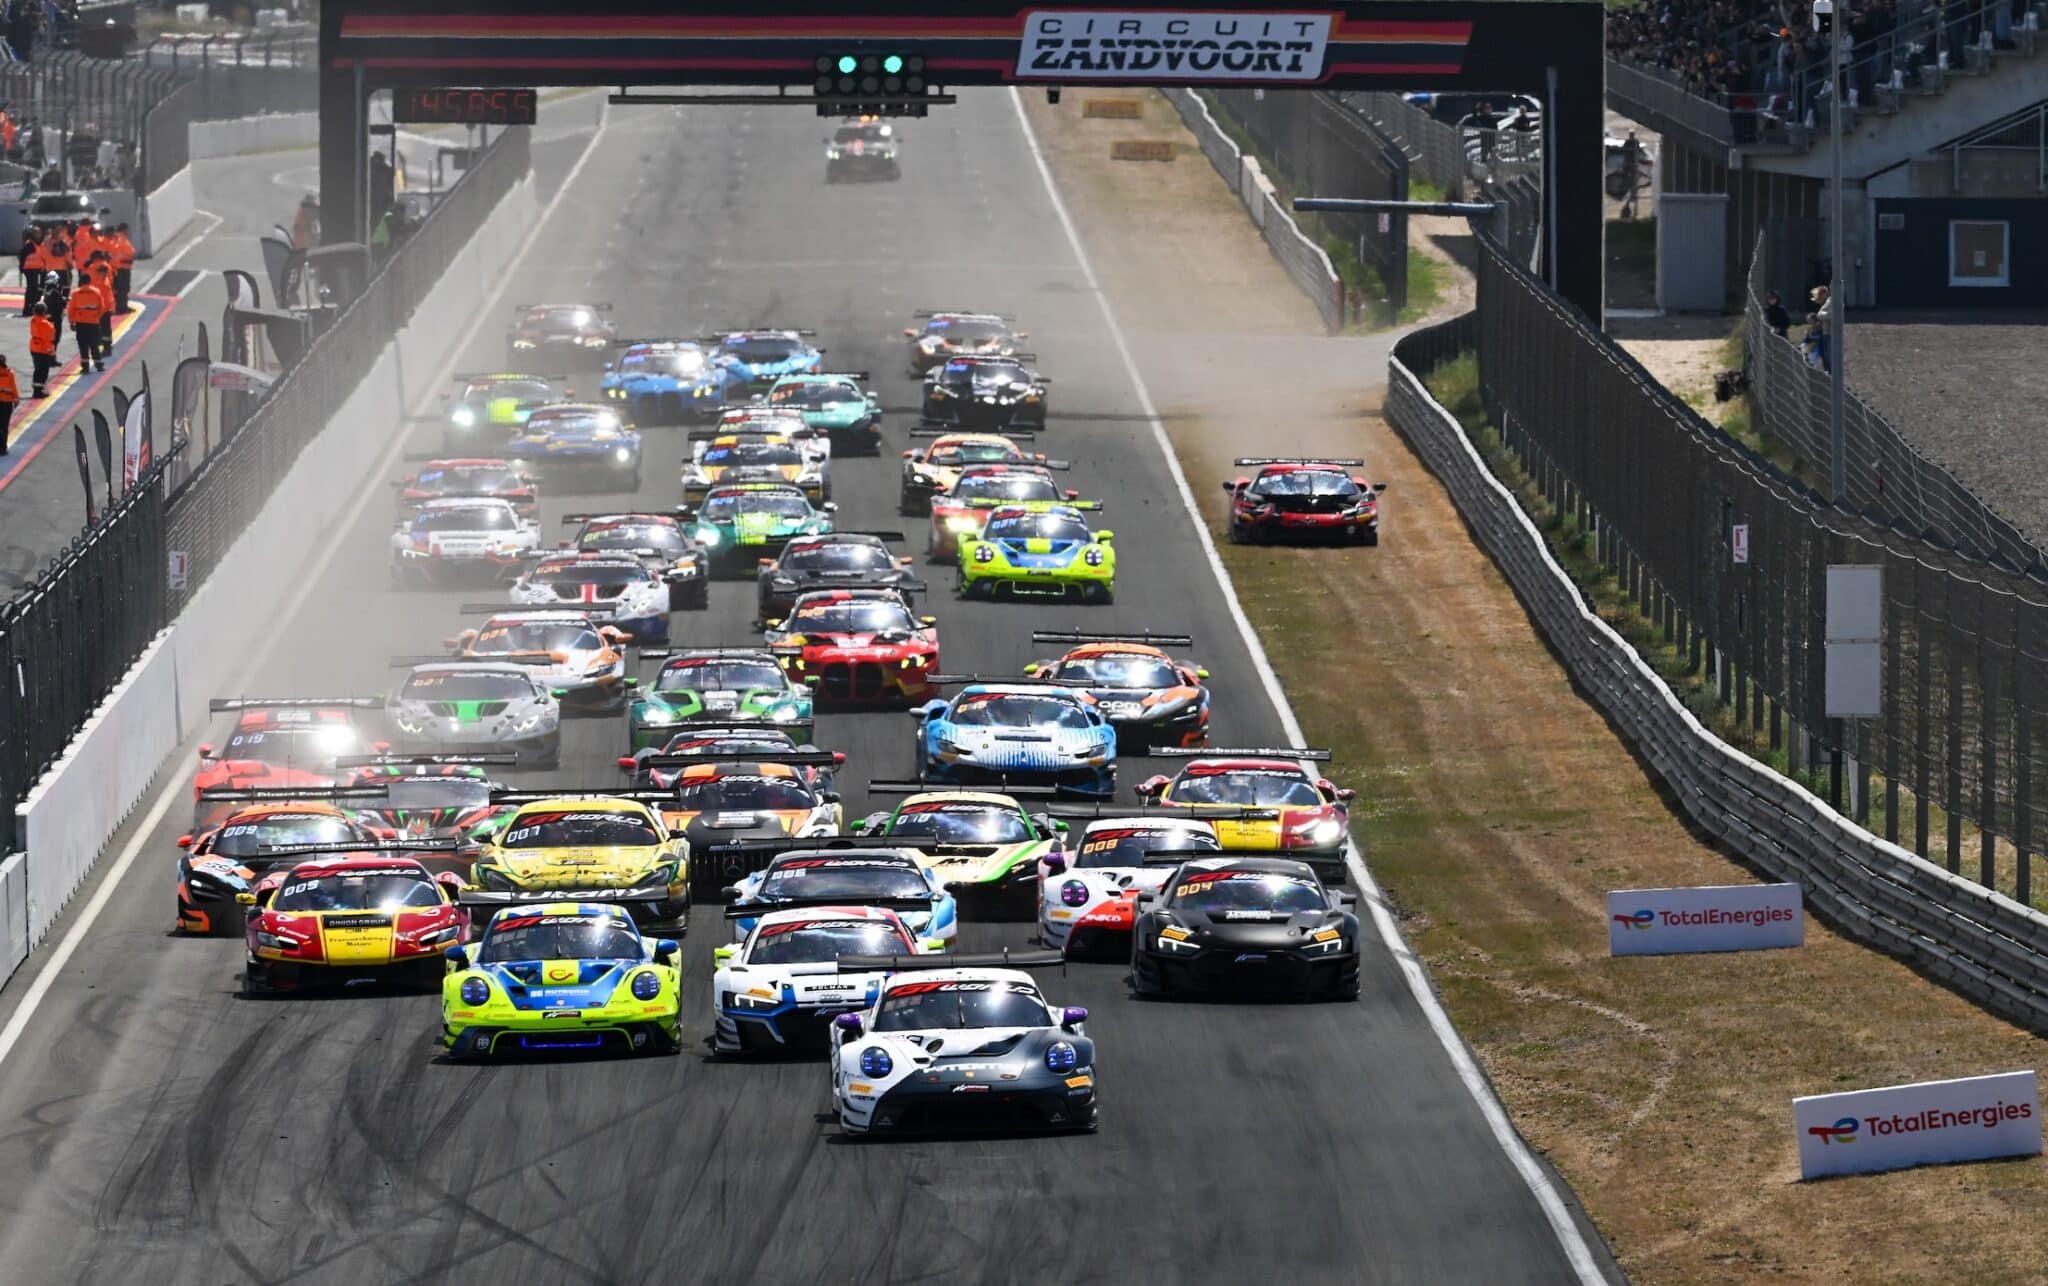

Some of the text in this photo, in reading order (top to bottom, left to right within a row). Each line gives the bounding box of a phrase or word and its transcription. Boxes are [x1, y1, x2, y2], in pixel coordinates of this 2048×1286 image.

[1039, 19, 1315, 37] CIRCUIT
[1030, 39, 1313, 72] ZANDVOORT
[507, 826, 541, 844] 007
[1175, 881, 1212, 898] 004
[1659, 905, 1793, 926] TotalEnergies
[1864, 1101, 2032, 1137] TotalEnergies
